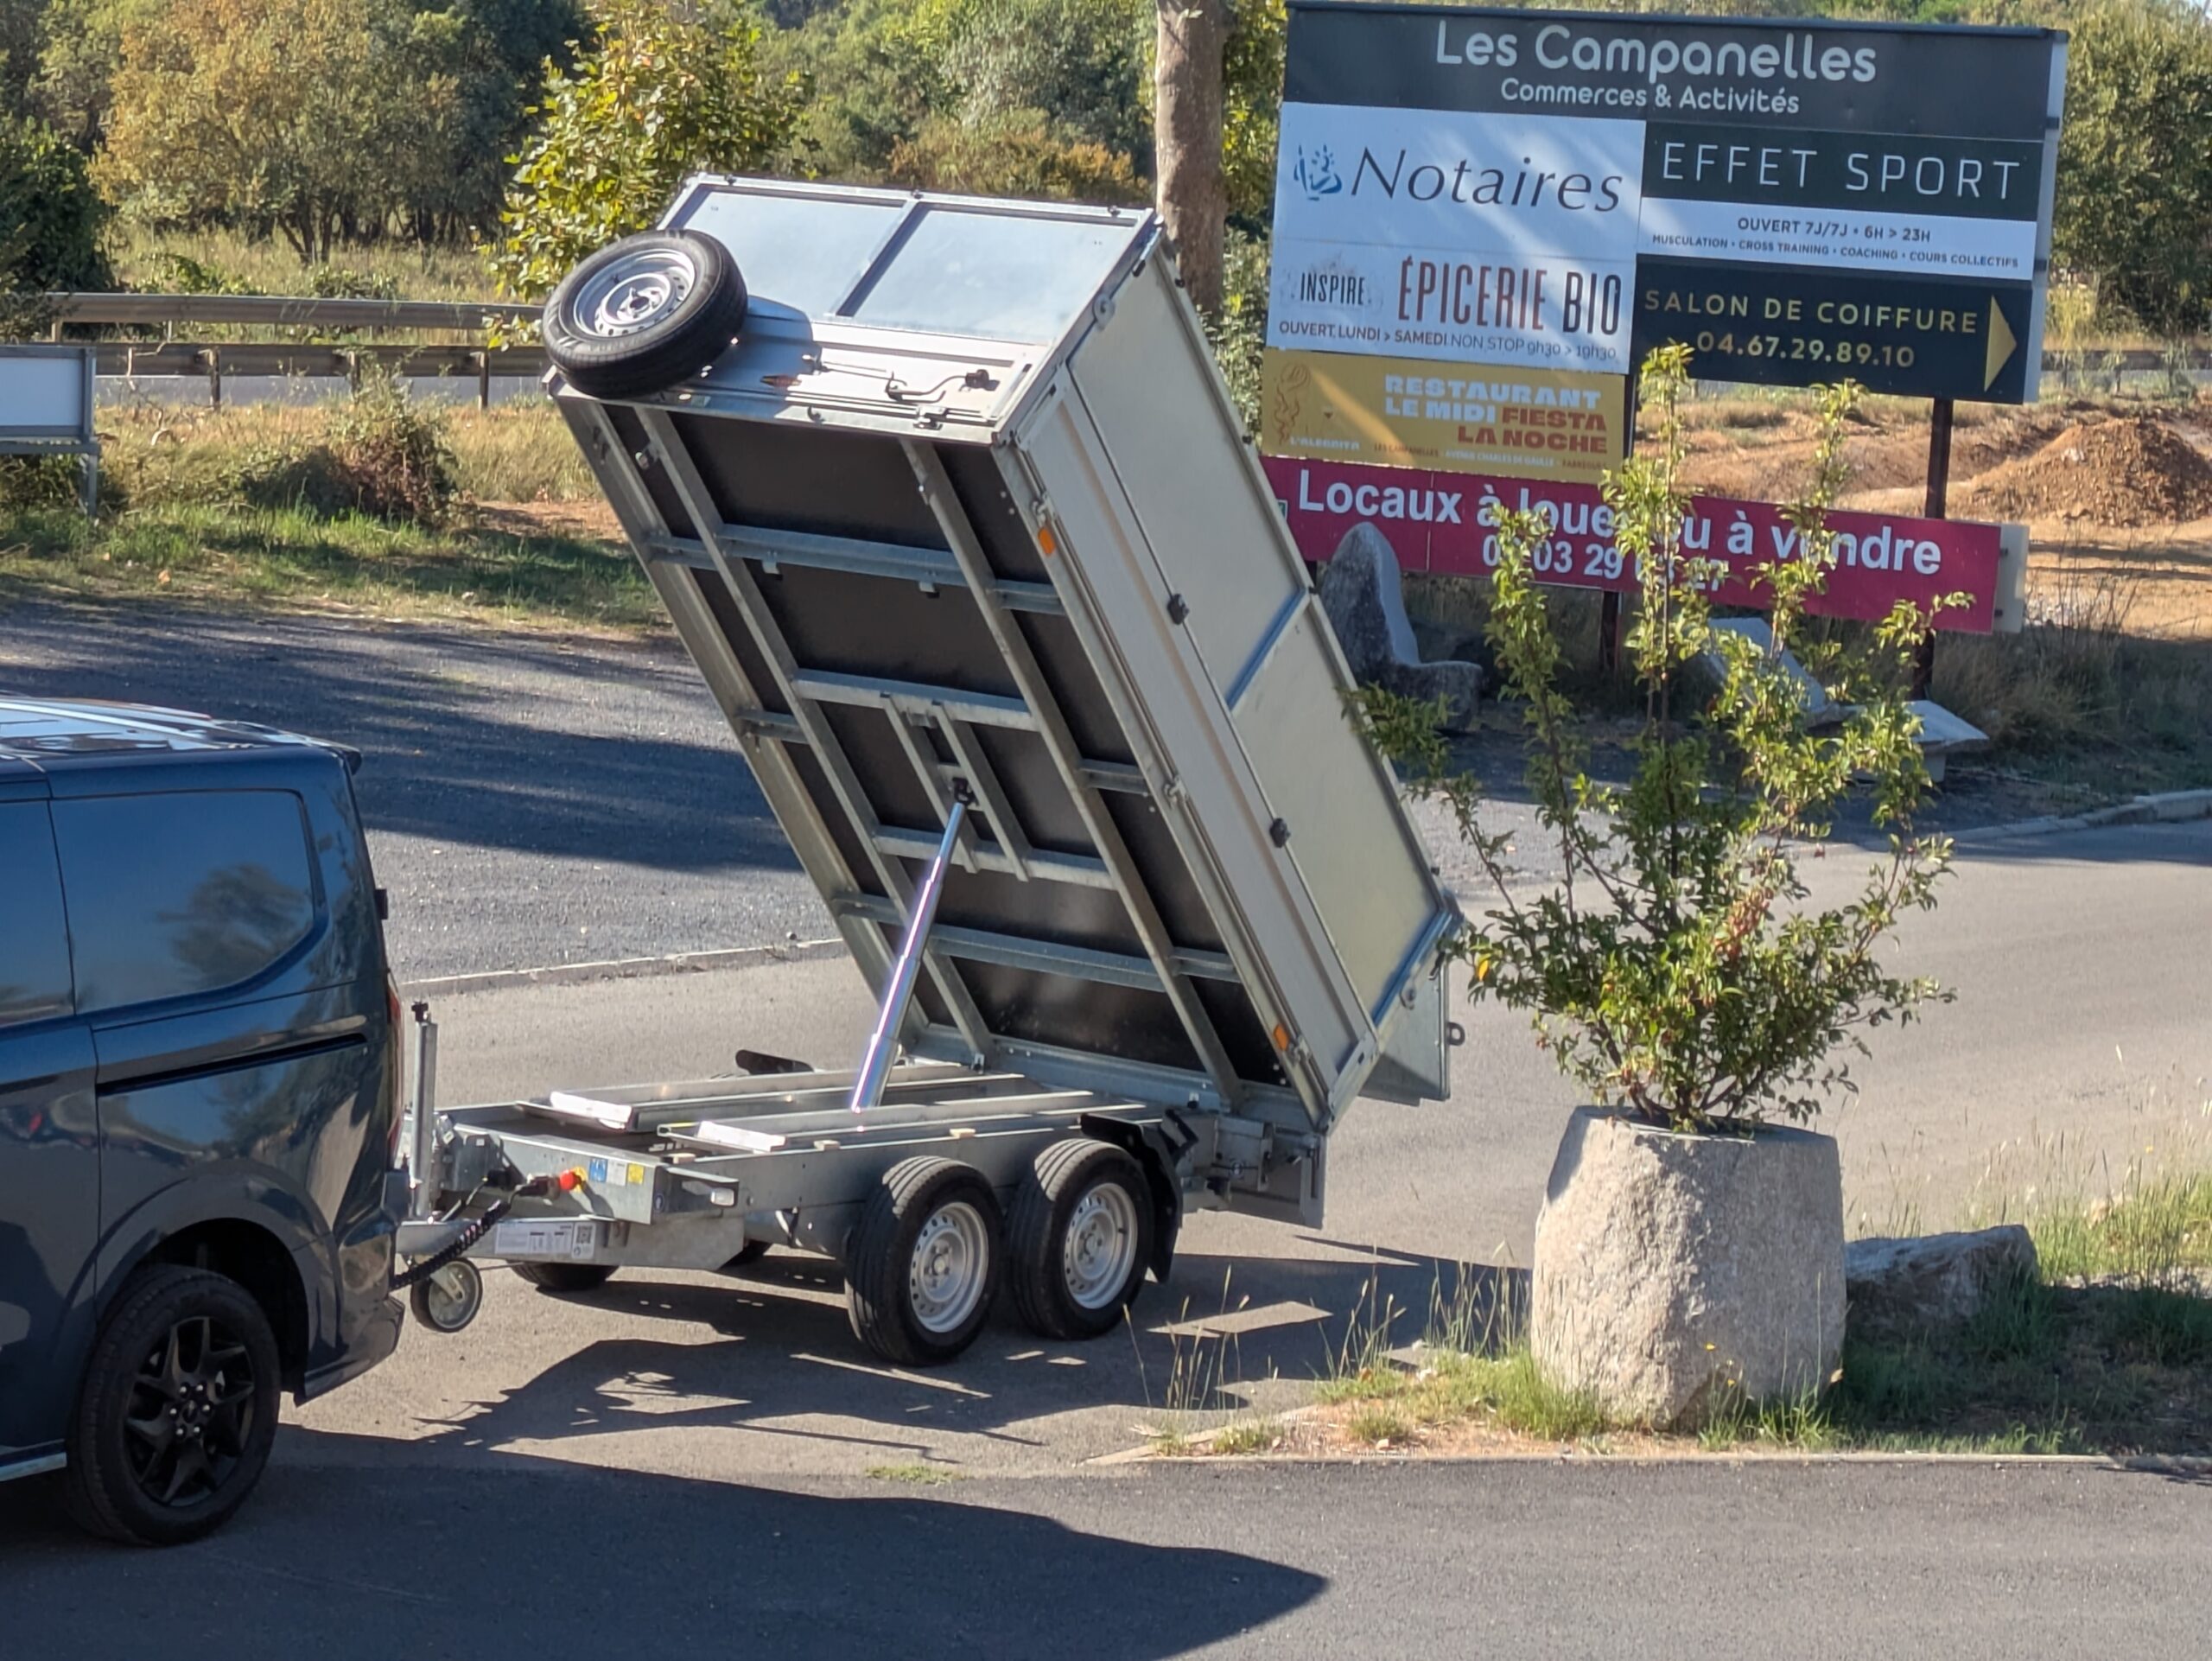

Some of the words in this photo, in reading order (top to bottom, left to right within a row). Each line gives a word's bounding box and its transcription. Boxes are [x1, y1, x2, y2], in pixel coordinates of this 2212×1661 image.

[1437, 19, 1517, 67] Les
[1535, 24, 1876, 84] Campanelles
[1501, 77, 1647, 106] Commerces
[1655, 83, 1671, 108] &
[1679, 85, 1799, 113] Activités
[1351, 145, 1623, 212] Notaires
[1662, 141, 1818, 188] EFFET
[1846, 152, 2020, 200] SPORT
[1738, 217, 1801, 234] OUVERT
[1805, 220, 1848, 239] 7J/7J
[1864, 225, 1884, 239] 6H
[1902, 227, 1930, 243] 23H
[1652, 233, 1728, 249] MUSCULATION
[1738, 239, 1774, 252] CROSS
[1777, 242, 1829, 256] TRAINING
[1840, 245, 1898, 260] COACHING
[1909, 251, 1947, 264] COURS
[1950, 253, 2018, 269] COLLECTIFS
[1300, 271, 1365, 306] INSPIRE
[1398, 255, 1548, 331] ÉPICERIE
[1562, 271, 1623, 336] BIO
[1644, 290, 1749, 317] SALON
[1764, 297, 1802, 321] DE
[1817, 302, 1978, 334] COIFFURE
[1279, 320, 1335, 338] OUVERT
[1338, 324, 1381, 341] LUNDI
[1395, 329, 1446, 346] SAMEDI
[1451, 334, 1484, 350] NON
[1487, 334, 1525, 353] STOP
[1527, 340, 1561, 358] 9h30
[1575, 344, 1617, 361] 19h30
[1697, 331, 1915, 368] 04.67.29.89.10
[1385, 374, 1601, 410] RESTAURANT
[1385, 397, 1419, 417] LE
[1426, 400, 1496, 423] MIDI
[1502, 406, 1607, 431] FIESTA
[1458, 425, 1497, 446] LA
[1503, 429, 1608, 454] NOCHE
[1299, 468, 1462, 525] Locaux
[1728, 510, 1754, 556] à
[1584, 543, 1624, 580] 29
